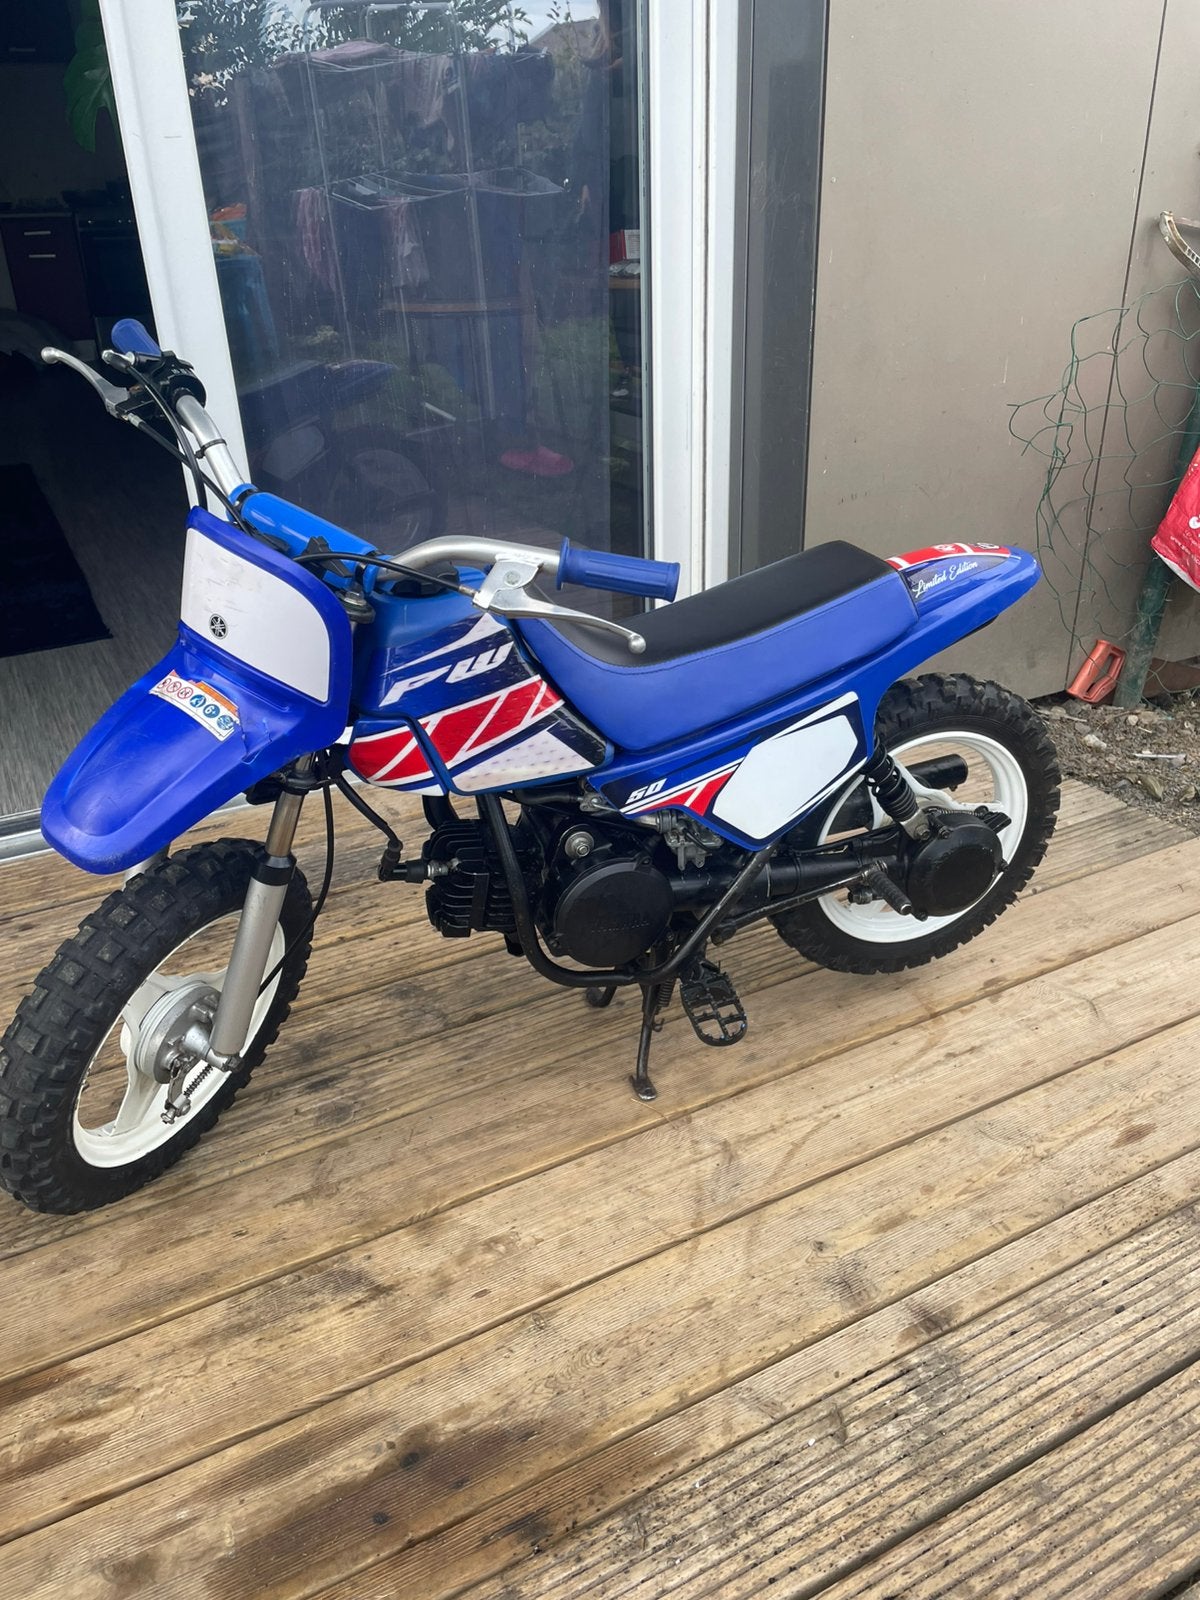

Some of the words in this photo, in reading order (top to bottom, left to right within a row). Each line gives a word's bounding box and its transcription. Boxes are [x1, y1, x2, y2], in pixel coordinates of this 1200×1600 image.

[912, 569, 947, 598] Limited
[949, 560, 978, 581] Edition
[378, 641, 515, 707] PW
[625, 778, 667, 804] 50
